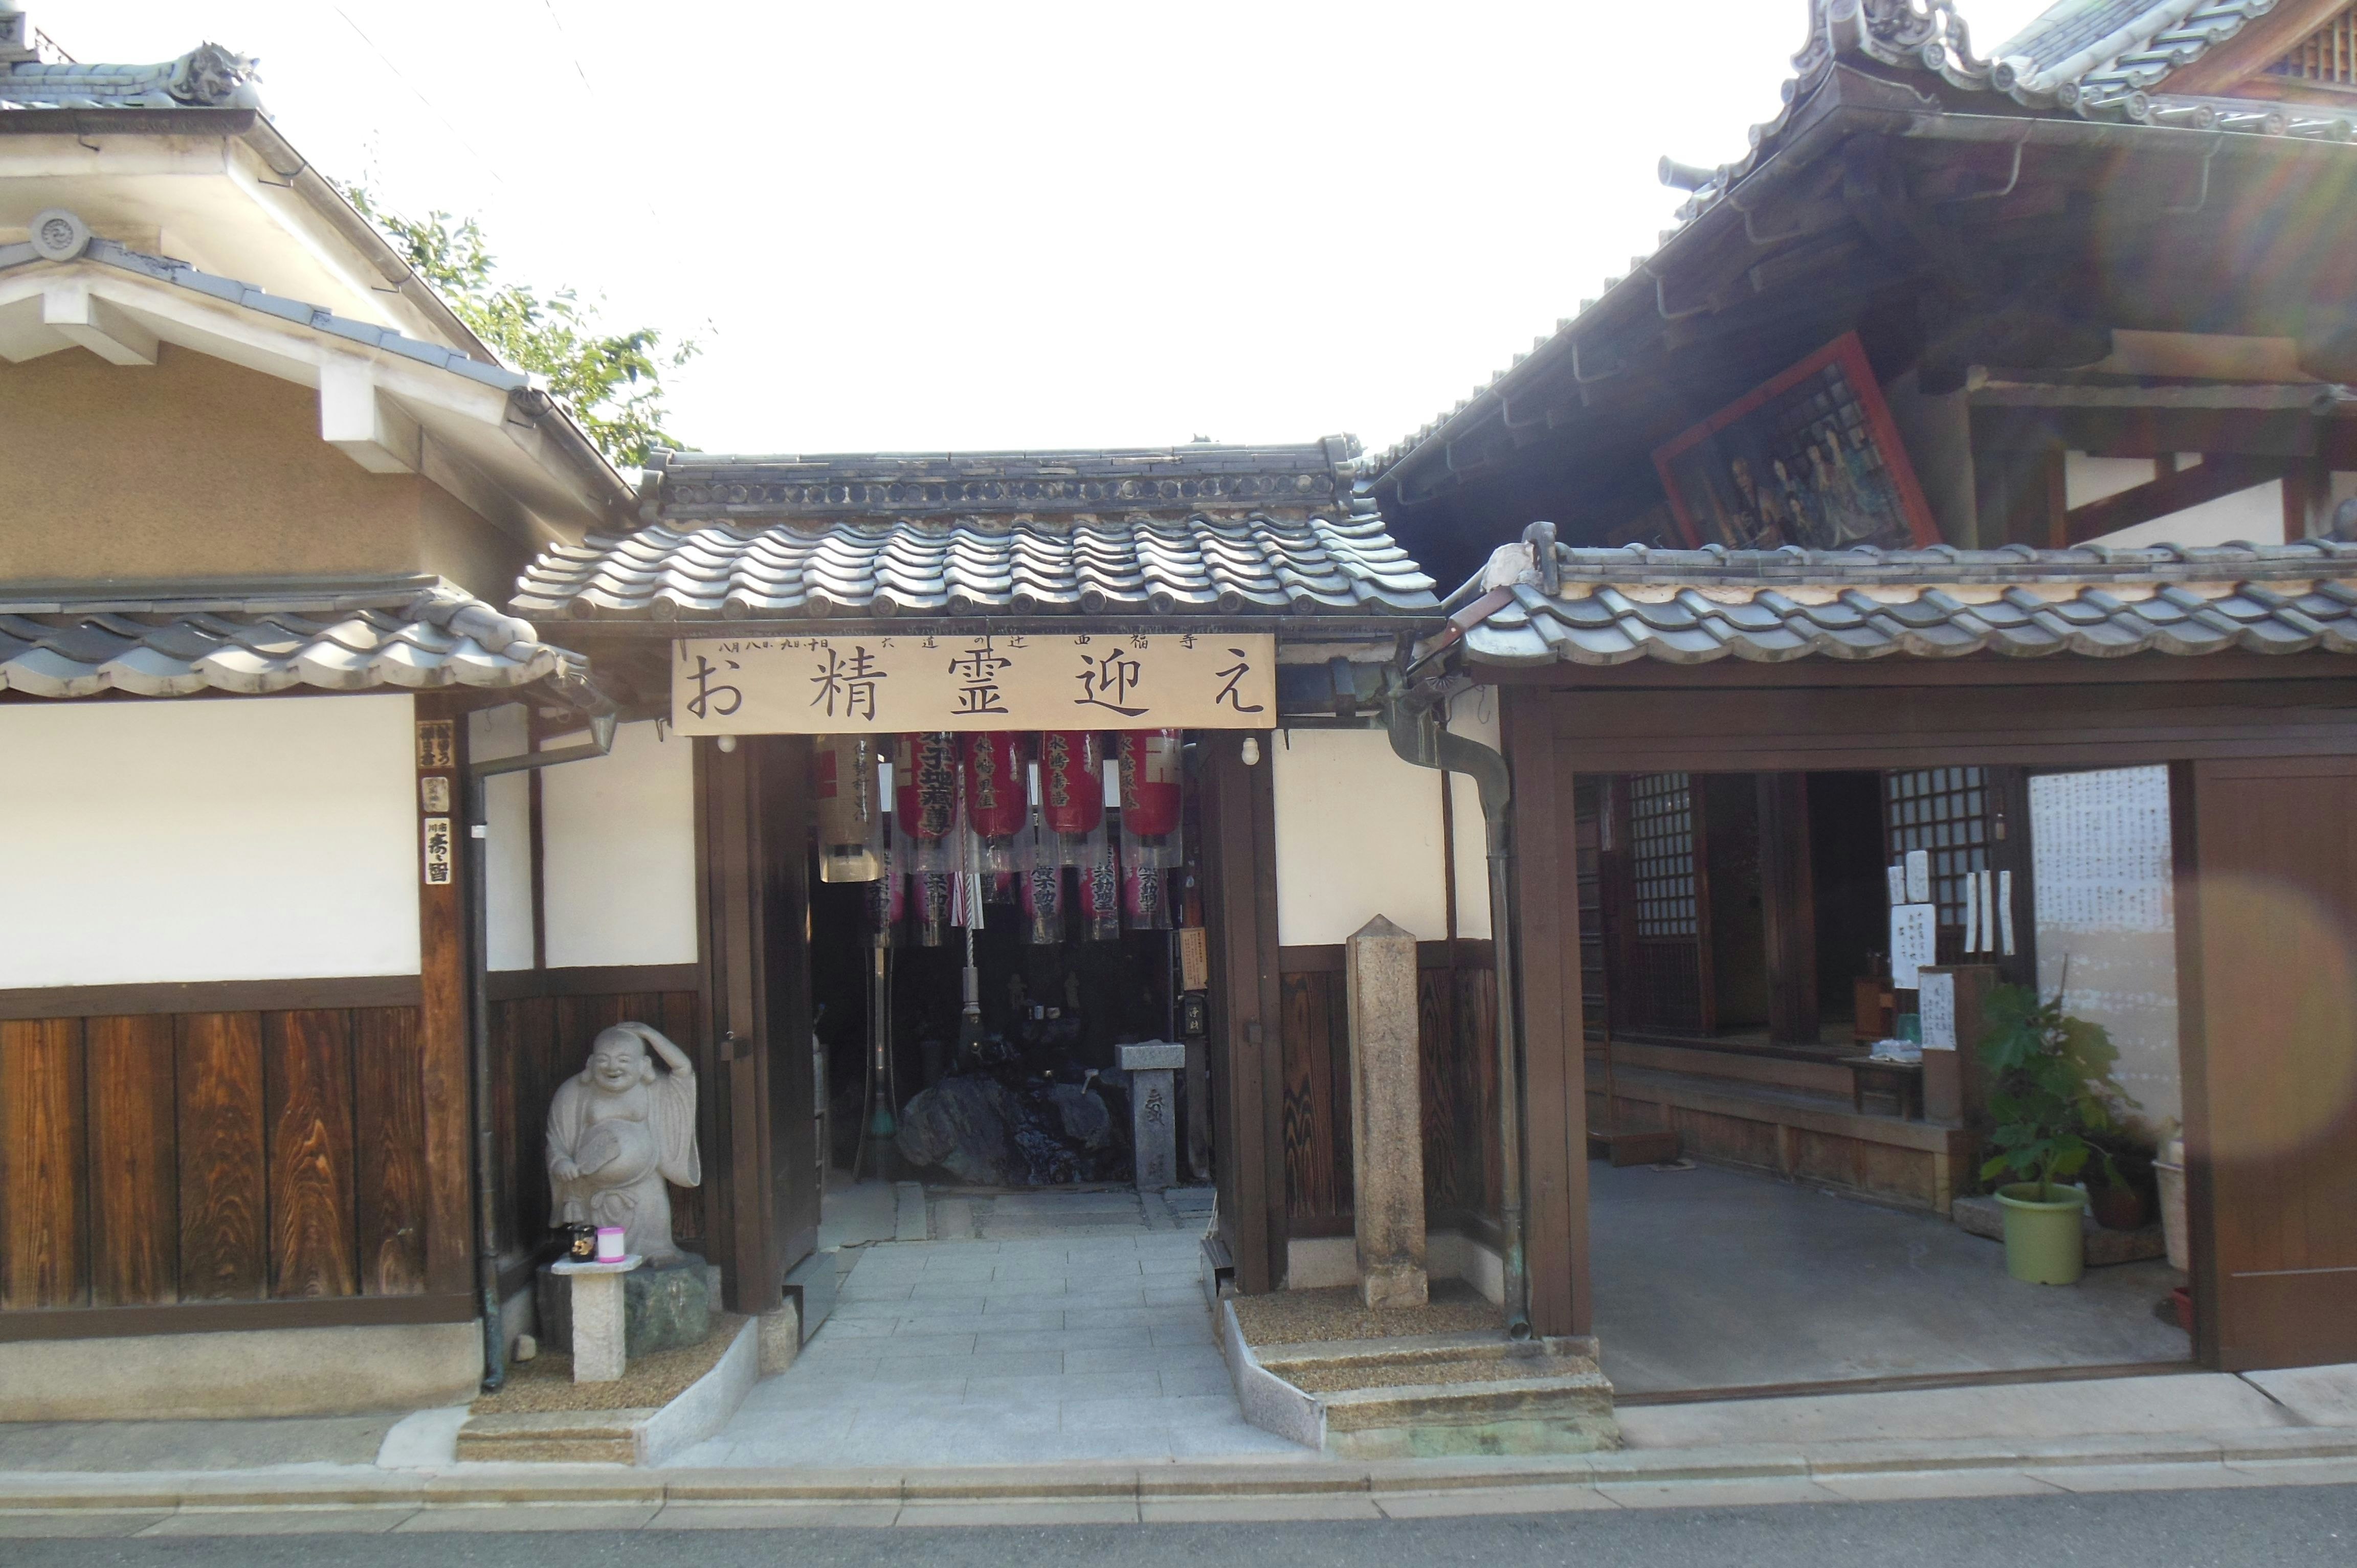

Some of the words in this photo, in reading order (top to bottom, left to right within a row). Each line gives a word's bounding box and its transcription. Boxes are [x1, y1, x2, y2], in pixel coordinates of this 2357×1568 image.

[686, 645, 1264, 722] お精霊迎え
